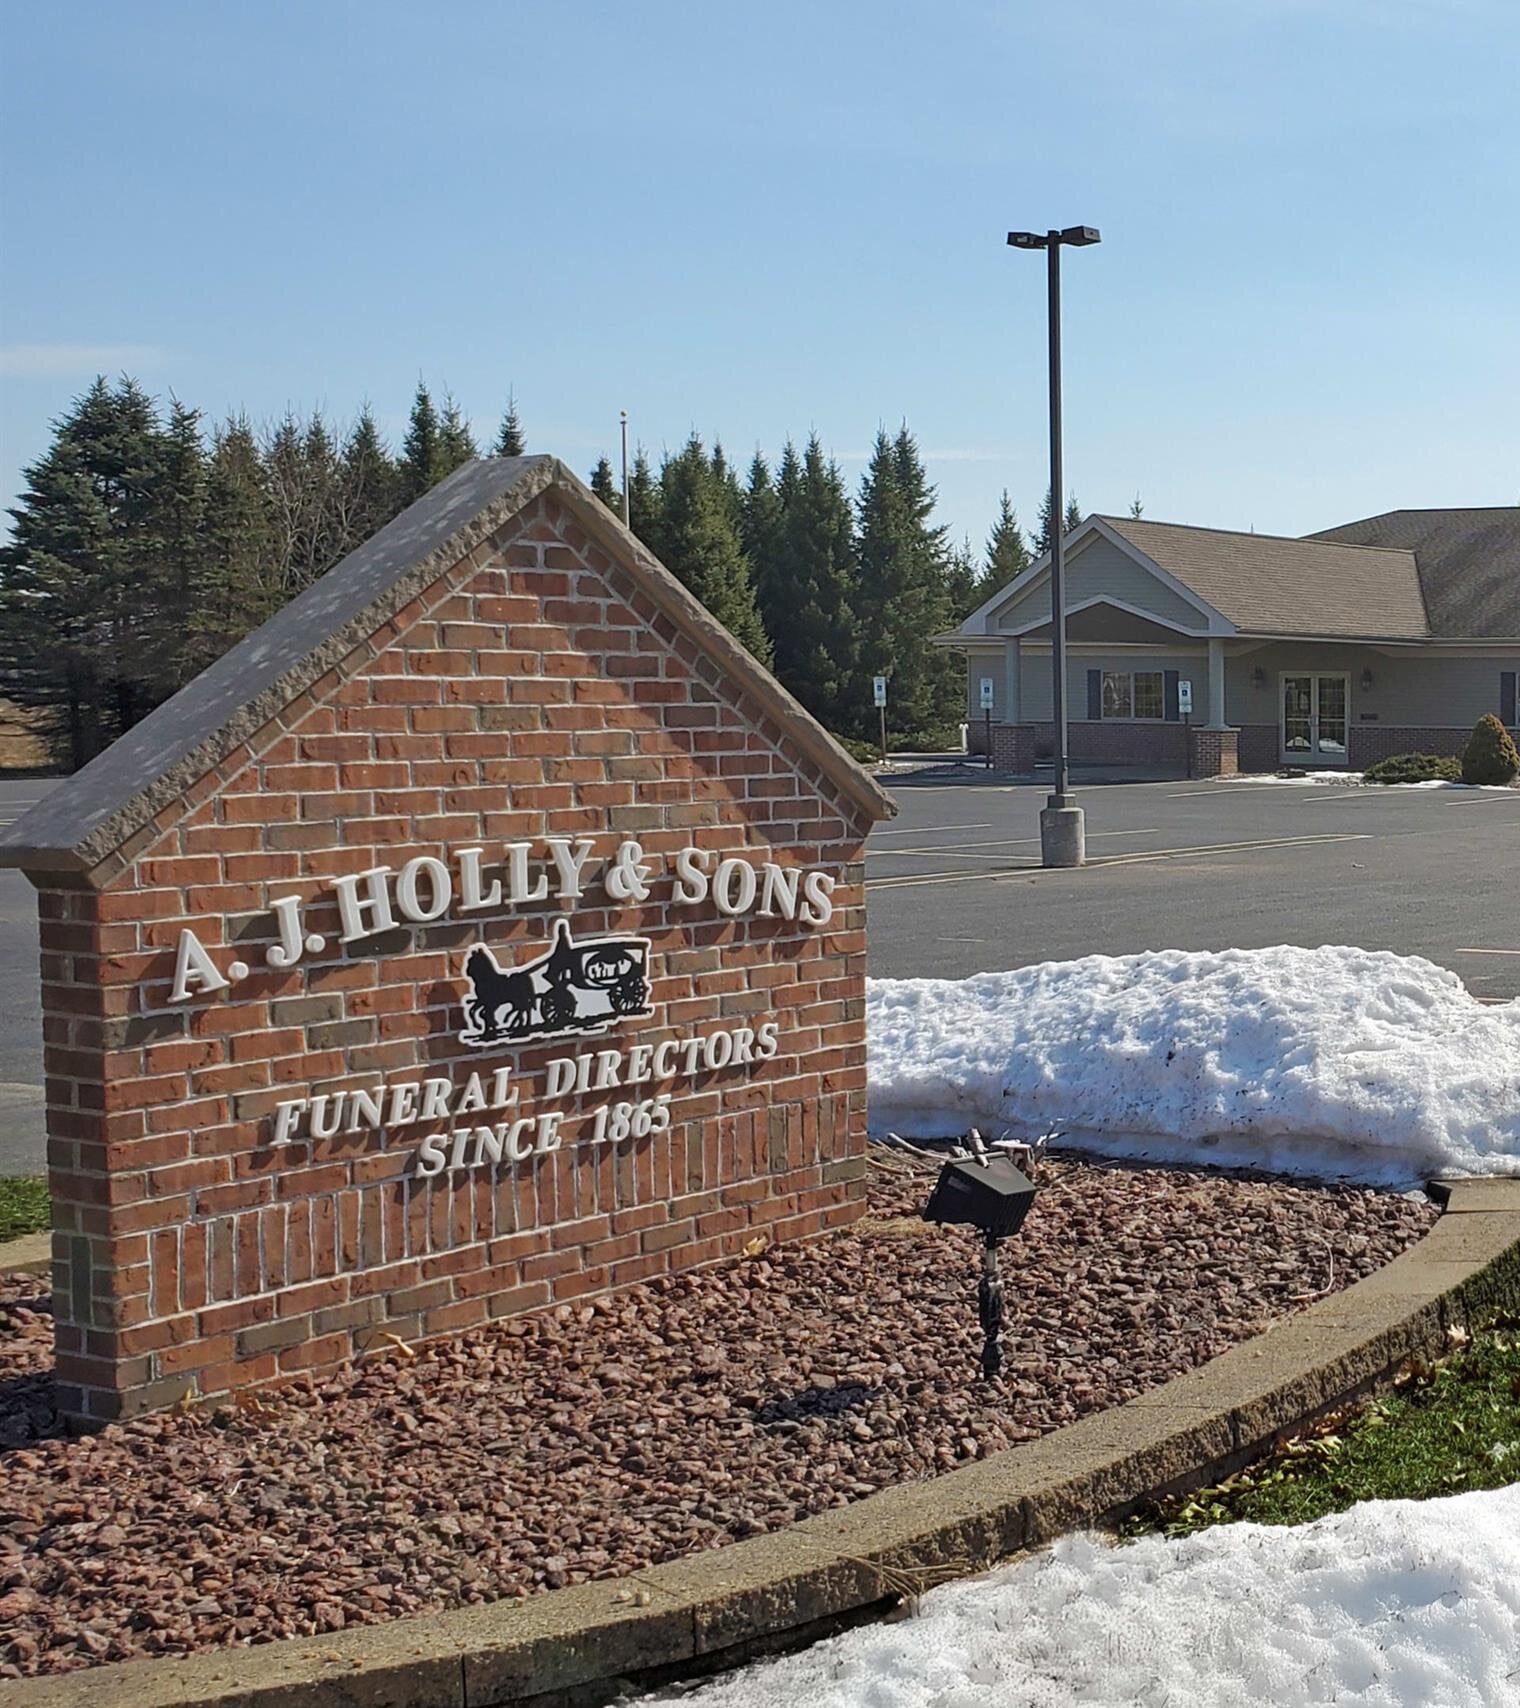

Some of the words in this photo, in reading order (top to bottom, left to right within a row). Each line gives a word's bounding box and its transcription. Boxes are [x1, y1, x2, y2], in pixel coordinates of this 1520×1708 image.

[167, 928, 249, 1003] A.
[266, 894, 326, 968] J.
[330, 838, 597, 945] HOLLY
[605, 840, 652, 901] &
[671, 847, 835, 926] SONS
[270, 1066, 520, 1147] FUNERAL
[544, 1022, 779, 1100] DIRECTORS
[415, 1112, 564, 1178] SINCE
[590, 1094, 672, 1144] 1865
